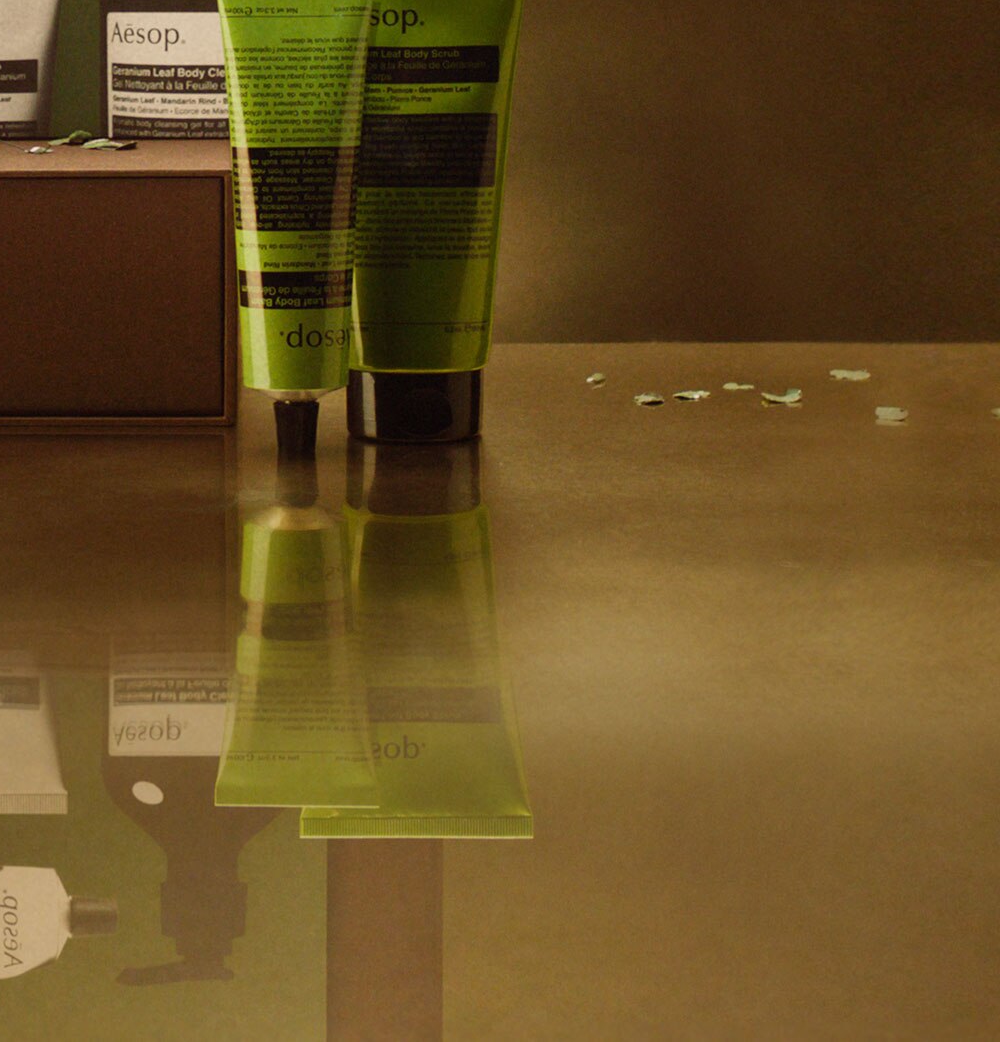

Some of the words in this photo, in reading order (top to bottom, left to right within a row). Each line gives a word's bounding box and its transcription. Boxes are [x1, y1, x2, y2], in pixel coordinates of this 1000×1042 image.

[370, 8, 425, 34] sop.
[381, 50, 402, 59] Leaf
[404, 49, 429, 60] Body
[431, 49, 460, 58] Scrub
[429, 61, 441, 69] de
[112, 65, 151, 76] Geranium
[153, 67, 175, 77] Leaf
[177, 67, 206, 79] Body
[124, 79, 165, 91] Nettoyant
[166, 79, 173, 90] à
[174, 80, 184, 90] la
[186, 80, 218, 90] Feuille
[455, 85, 472, 93] Leaf
[198, 97, 217, 105] Rind
[201, 106, 210, 114] de
[275, 296, 301, 307] Body
